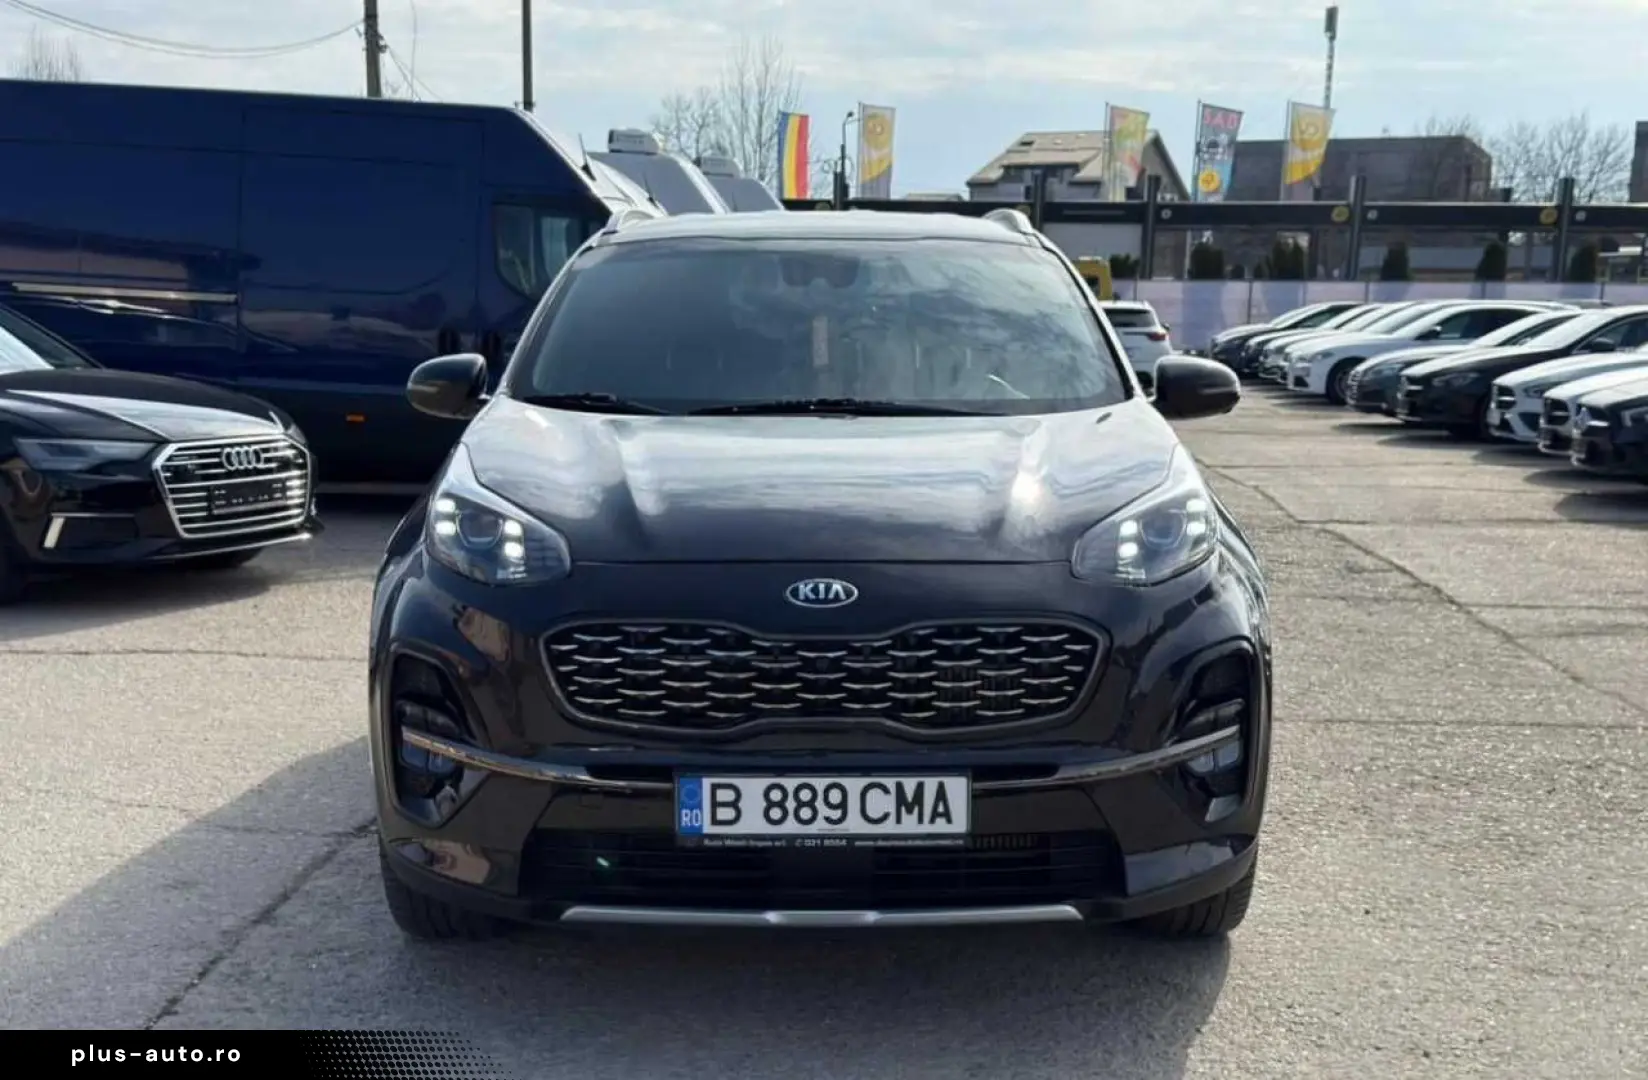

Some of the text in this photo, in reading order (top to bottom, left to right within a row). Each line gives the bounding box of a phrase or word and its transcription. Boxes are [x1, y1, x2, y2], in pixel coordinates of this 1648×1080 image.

[798, 582, 846, 600] KIA
[710, 781, 954, 826] B 889 CMA
[681, 808, 701, 827] RO
